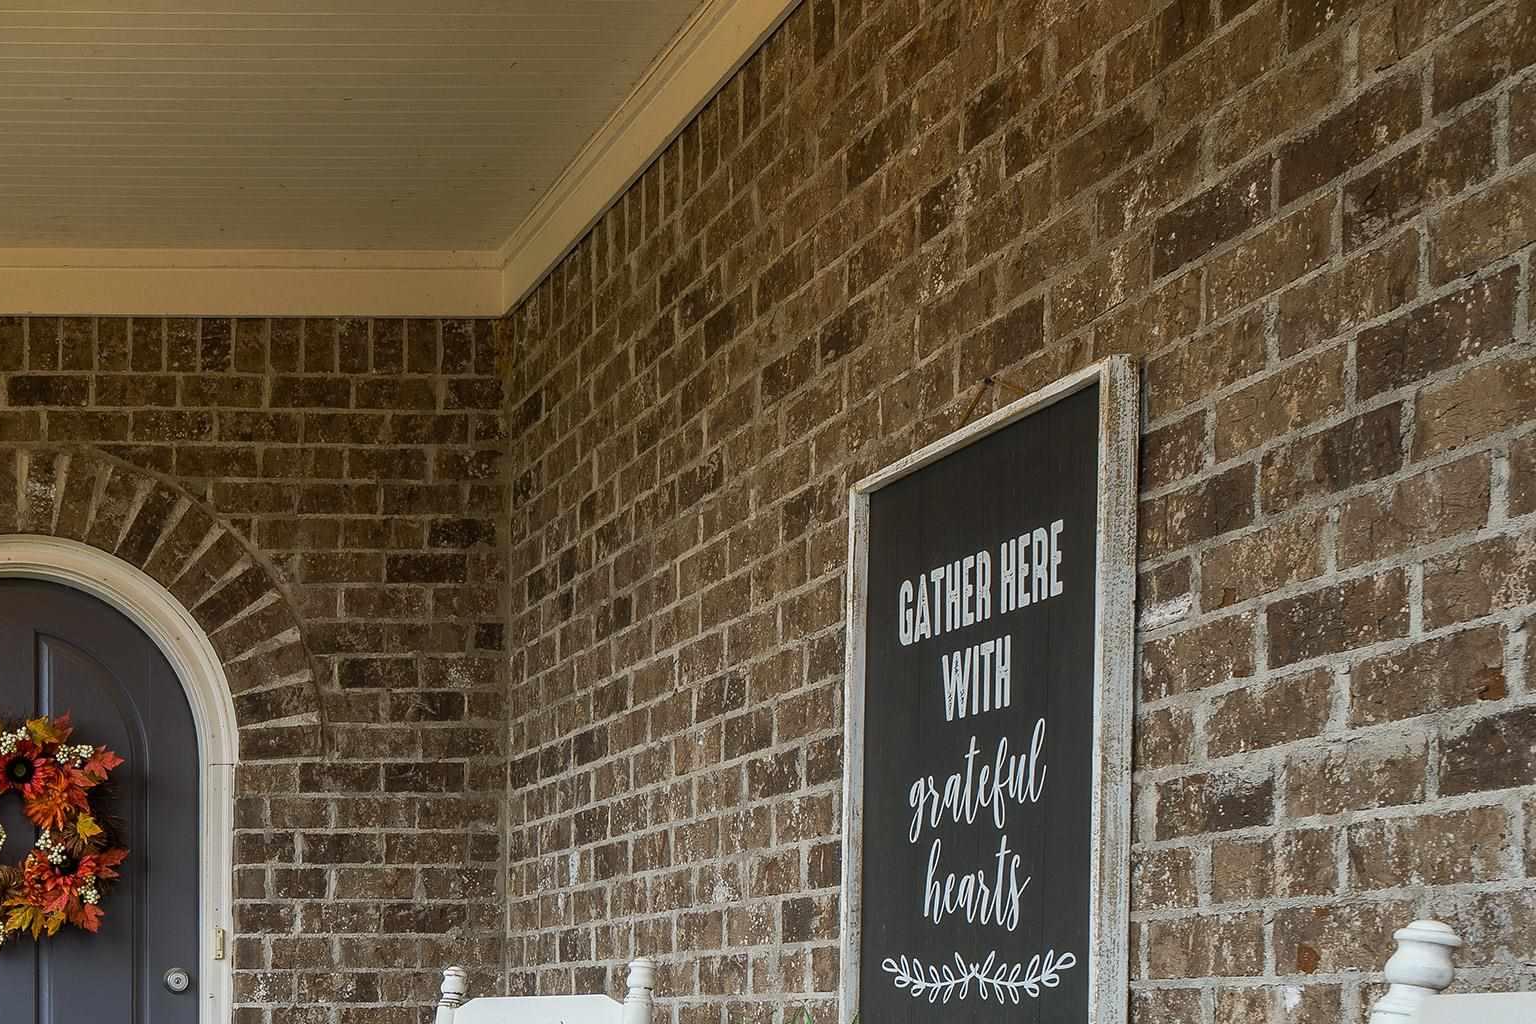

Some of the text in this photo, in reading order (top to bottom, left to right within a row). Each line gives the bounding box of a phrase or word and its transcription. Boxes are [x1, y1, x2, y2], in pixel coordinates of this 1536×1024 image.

[899, 519, 1064, 646] GATHER HERE
[942, 634, 1011, 721] WITH
[909, 718, 1047, 843] grateful
[923, 835, 1031, 931] hearts
